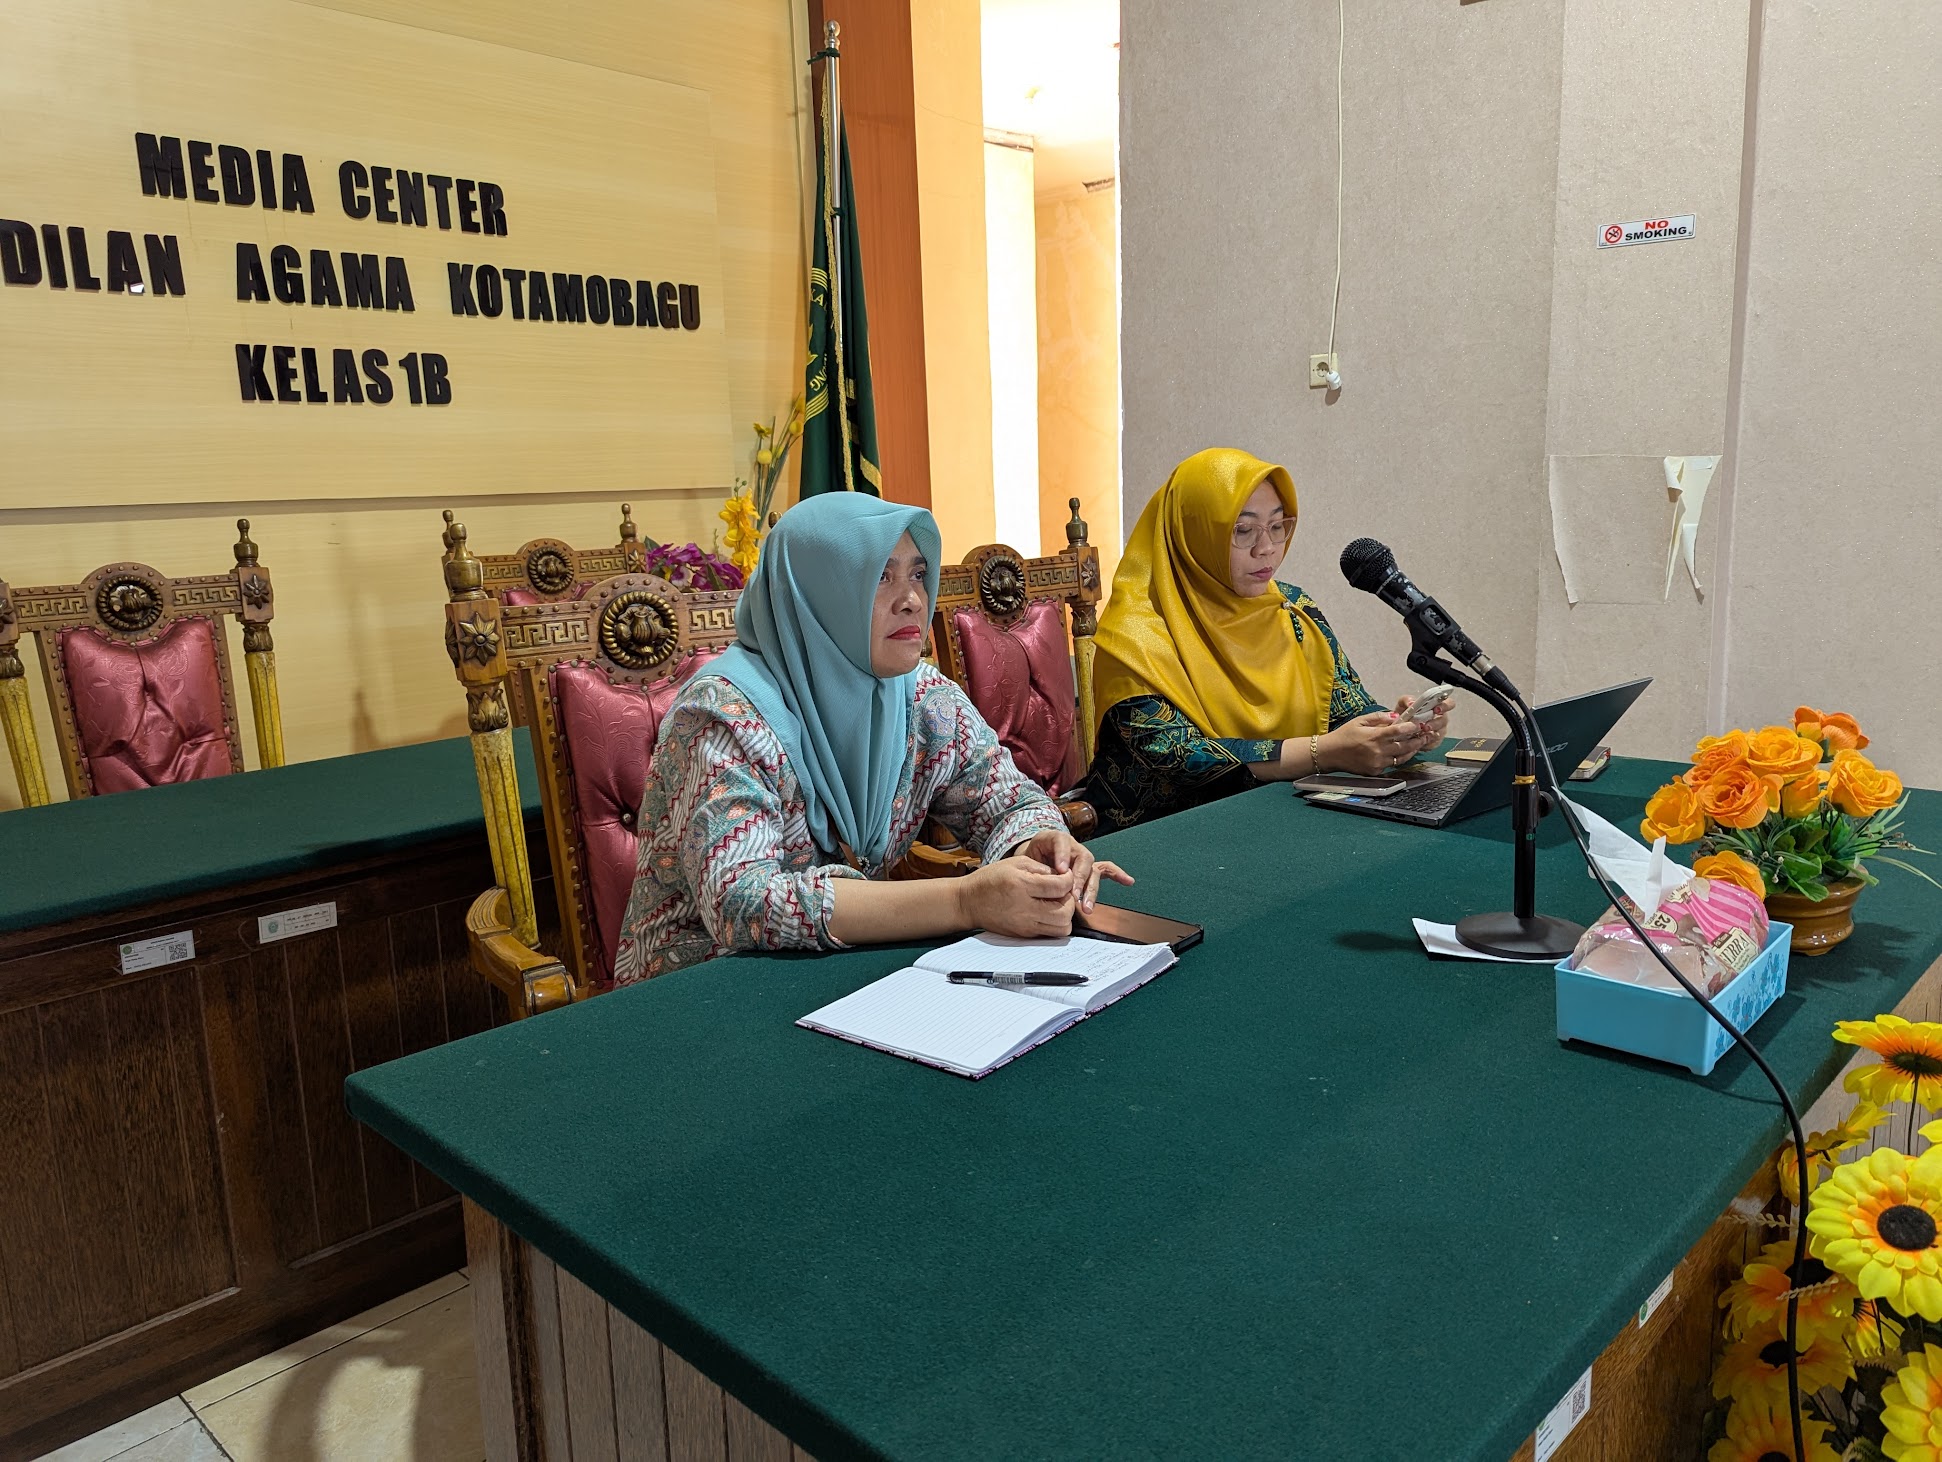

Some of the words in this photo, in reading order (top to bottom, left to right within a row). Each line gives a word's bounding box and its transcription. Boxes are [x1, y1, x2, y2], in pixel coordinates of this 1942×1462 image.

[135, 132, 316, 214] MEDIA
[338, 160, 508, 237] CENTER
[1625, 226, 1687, 241] SMOKING
[1645, 220, 1669, 230] NO
[0, 218, 186, 296] DILAN
[236, 242, 416, 312] AGAMA
[446, 262, 701, 331] KOTAMOBAGU
[1654, 914, 1671, 929] 25
[1719, 934, 1750, 964] ERRA
